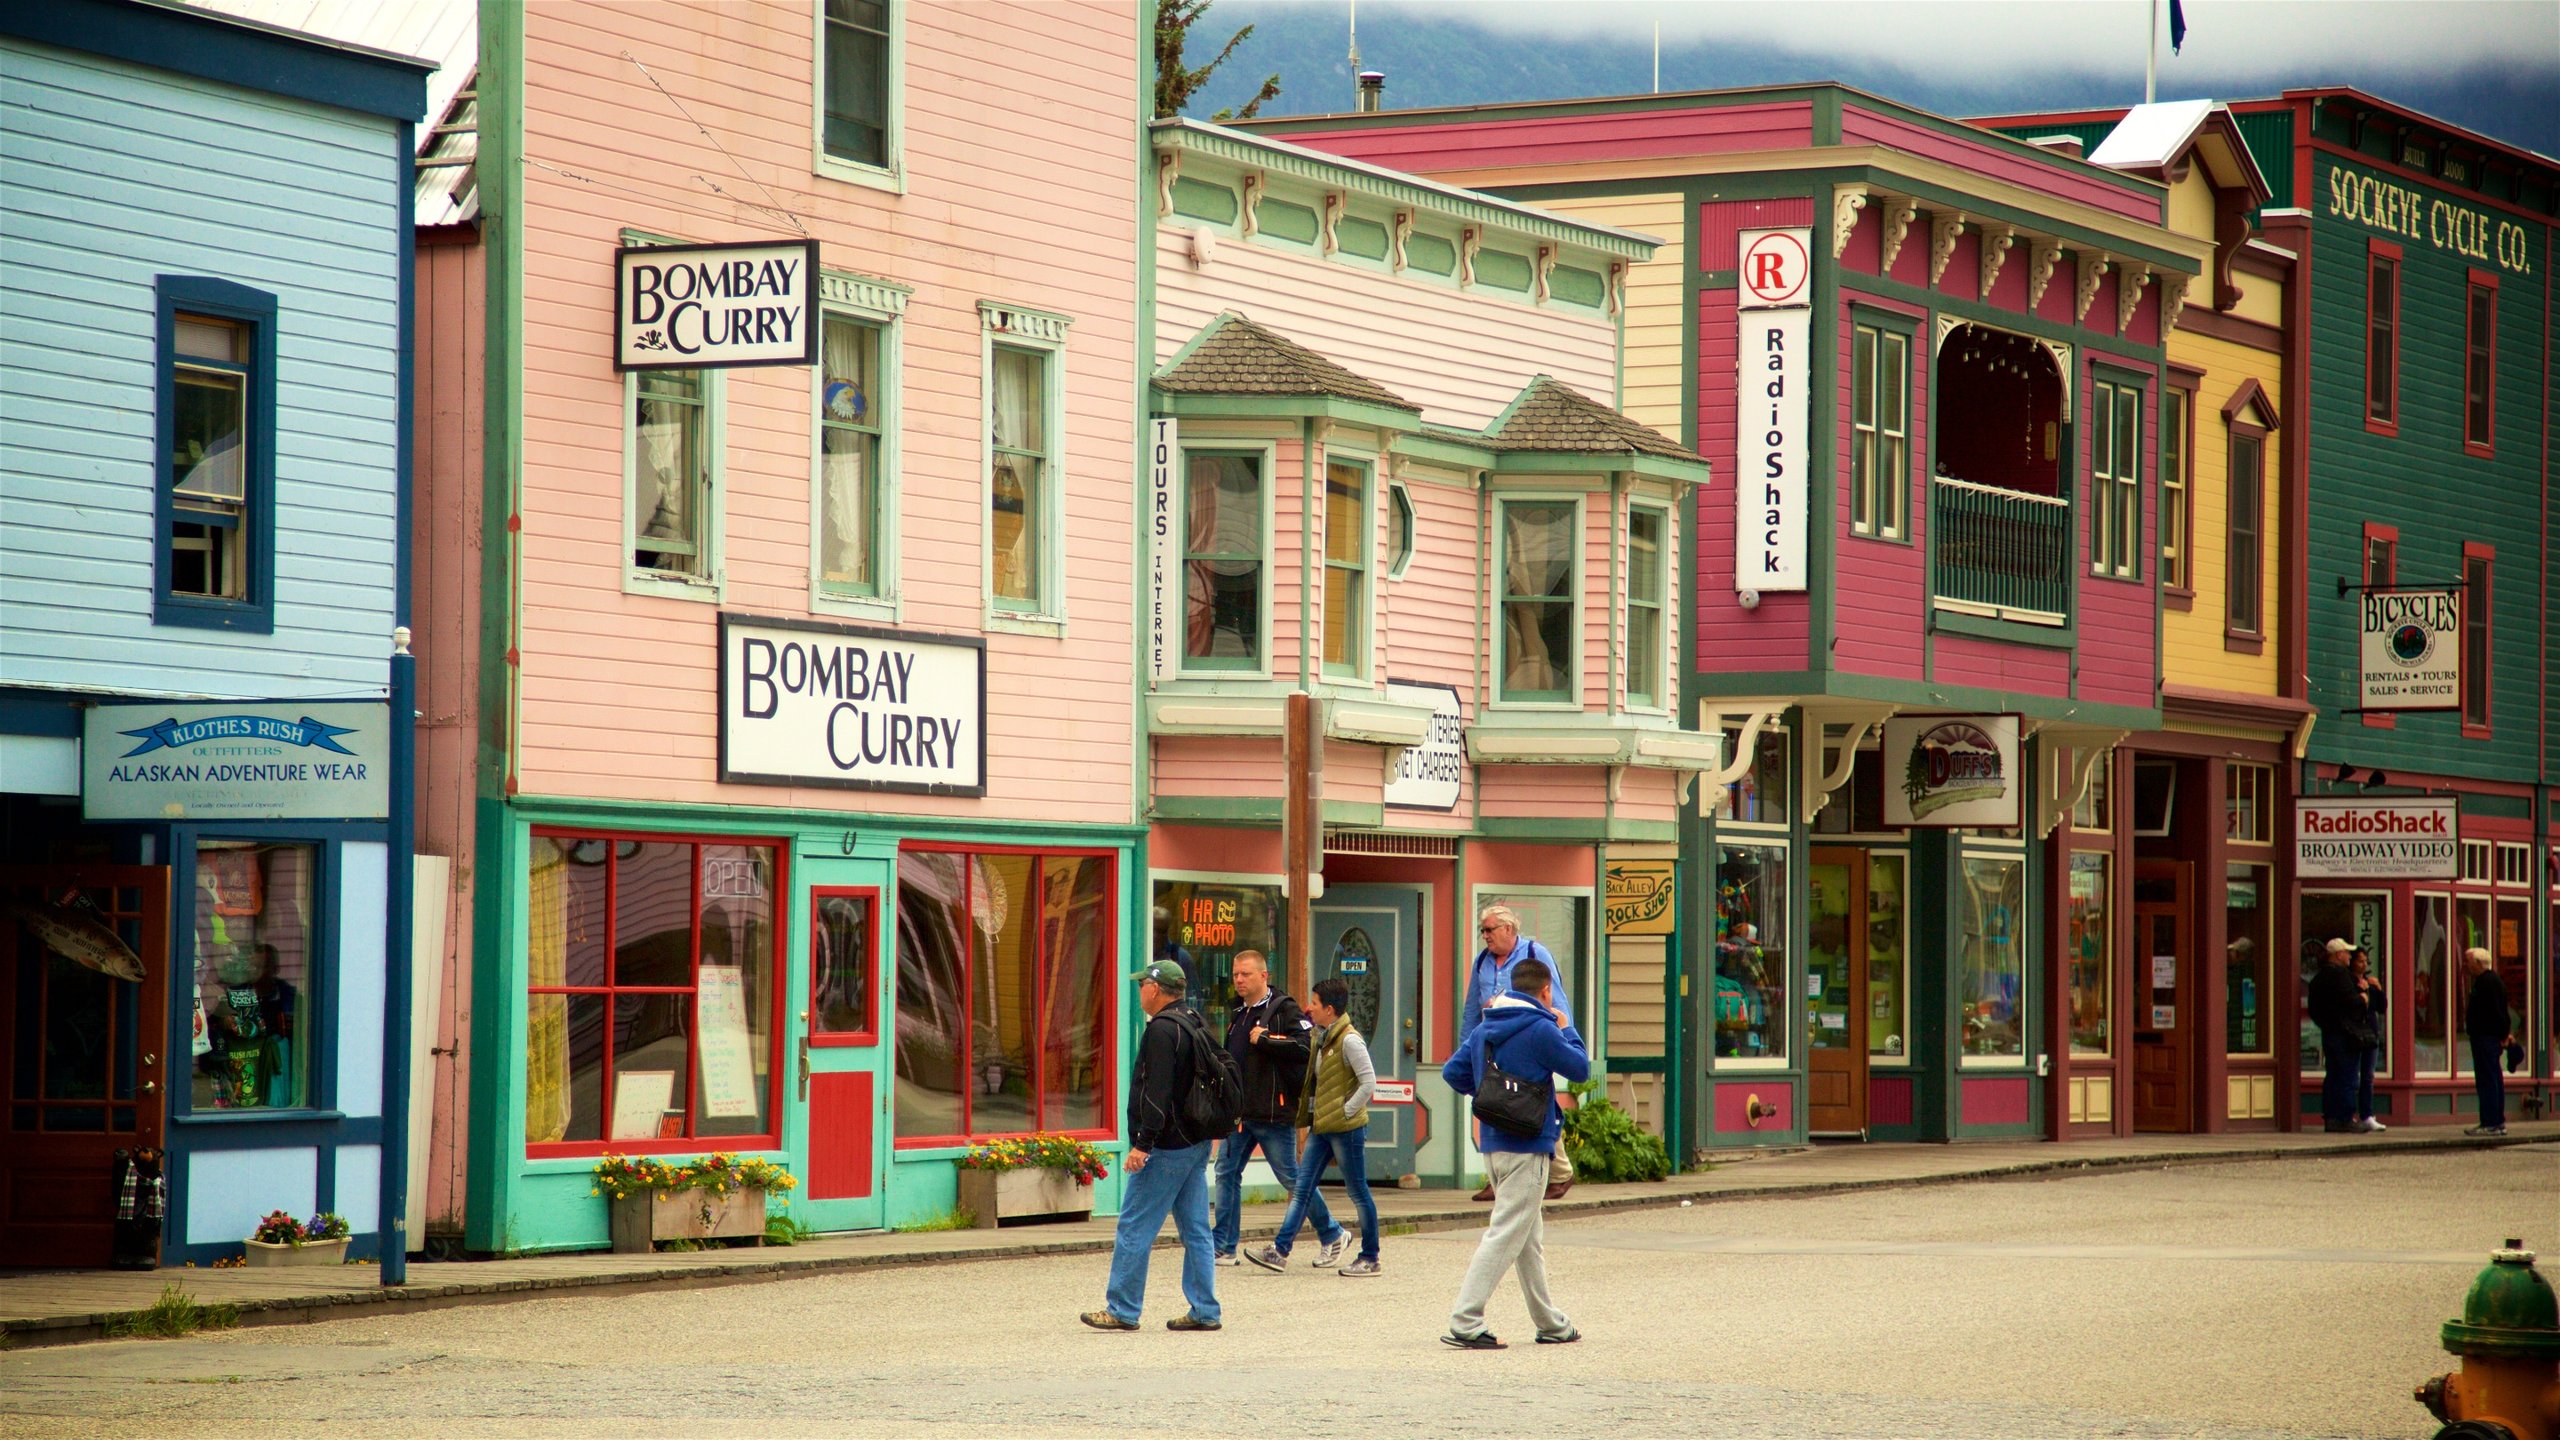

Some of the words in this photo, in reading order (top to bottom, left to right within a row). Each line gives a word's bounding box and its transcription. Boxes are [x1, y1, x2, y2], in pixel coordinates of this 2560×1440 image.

[2404, 146, 2426, 168] BUILT
[2444, 160, 2464, 181] 2000
[2330, 165, 2422, 240] SOCKEYE
[2430, 199, 2489, 261] CYCLE
[2498, 220, 2531, 275] CO.
[1753, 252, 1787, 290] R
[632, 258, 799, 325] BOMBAY
[667, 301, 801, 354] CURRY
[1764, 327, 1785, 573] RadioShack
[1155, 421, 1168, 536] TOURS
[1154, 555, 1163, 677] INTERNET
[2364, 595, 2457, 632] BICYCLES
[743, 637, 915, 720] BOMBAY
[2365, 672, 2410, 682] RENTALS
[2421, 671, 2457, 680] TOURS
[2369, 686, 2399, 695] SALES
[2410, 685, 2453, 695] SERVICE
[172, 720, 252, 744] KLOTHES
[258, 720, 304, 742] RUSH
[826, 702, 961, 771] CURRY
[192, 746, 283, 756] OUTFITTERS
[1417, 750, 1459, 783] CHARGERS
[1928, 747, 1993, 788] DUFF'S
[109, 765, 200, 783] ALASKAN
[205, 764, 308, 782] ADVENTURE
[313, 764, 368, 781] WEAR
[2304, 810, 2447, 834] RadioShack
[2301, 843, 2397, 858] BROADWAY
[2400, 843, 2454, 858] VIDEO
[706, 861, 762, 895] OPEN
[1606, 880, 1624, 894] BACK
[1627, 880, 1653, 893] ALLEY
[1193, 899, 1213, 922] HR
[1606, 905, 1640, 928] ROCK
[1644, 885, 1672, 916] SHOP
[1194, 924, 1235, 946] PHOTO
[1346, 961, 1363, 971] OPEN
